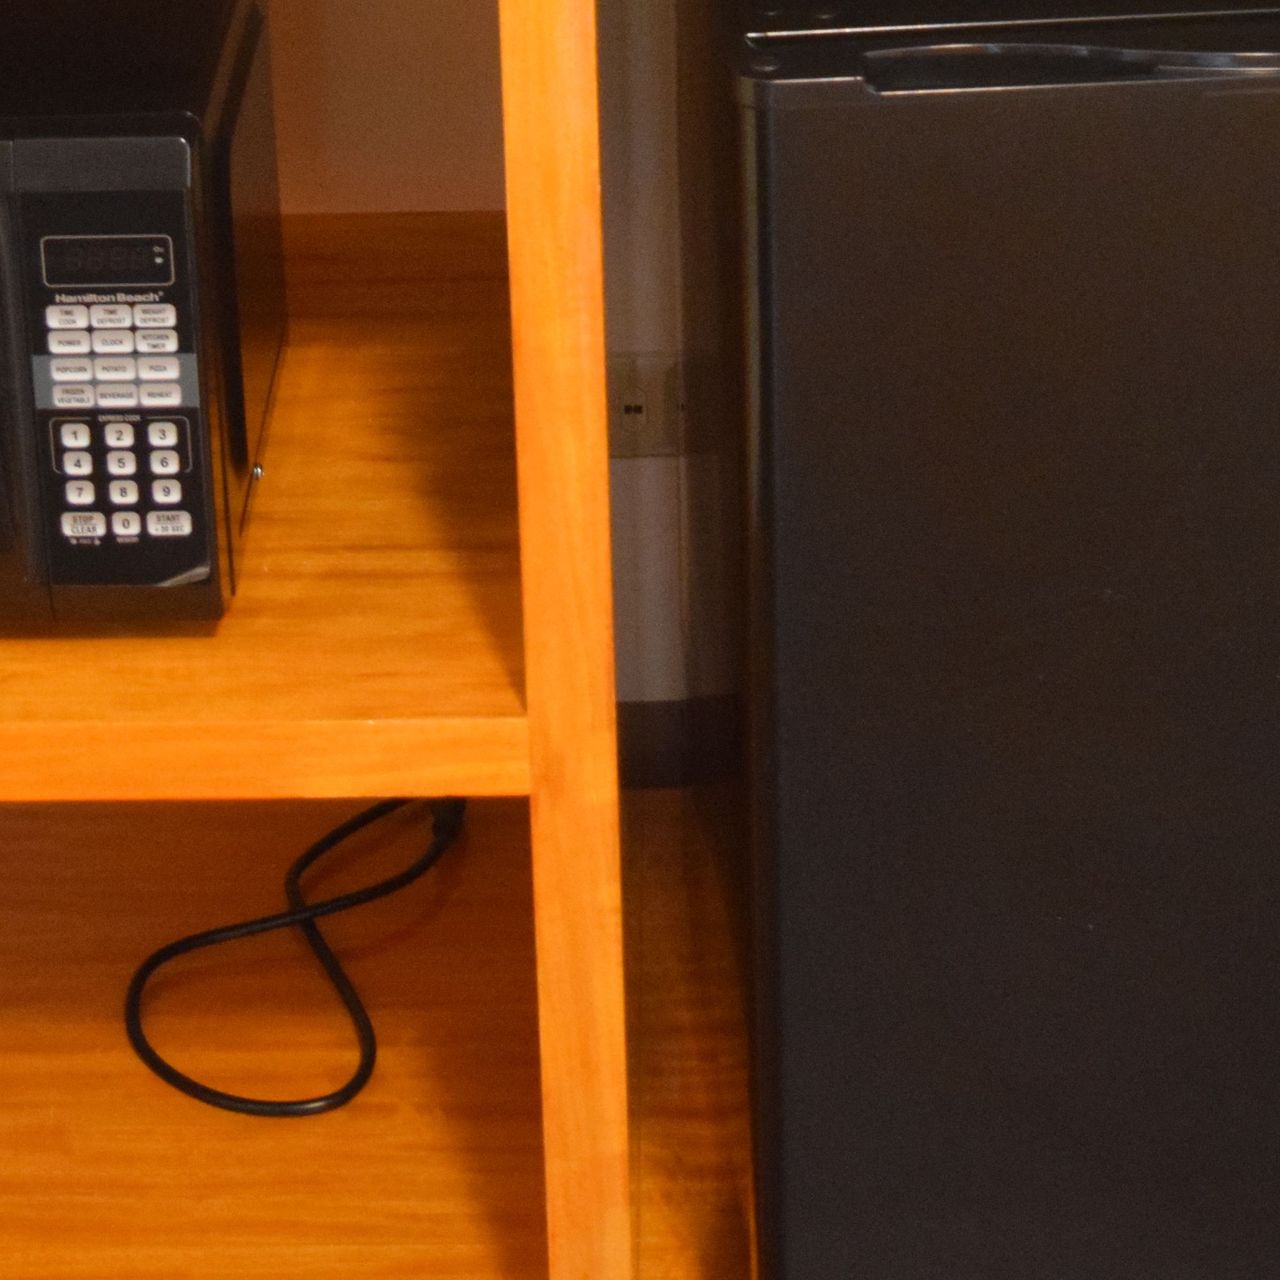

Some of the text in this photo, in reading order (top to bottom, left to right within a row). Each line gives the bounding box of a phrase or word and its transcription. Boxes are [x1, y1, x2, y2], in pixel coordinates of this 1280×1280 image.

[55, 292, 160, 303] Hamilton Beach
[55, 365, 87, 373] POPCORN
[102, 365, 127, 373] POTATO
[115, 429, 124, 441] 2
[159, 428, 168, 440] 3
[74, 458, 82, 469] 4
[117, 457, 126, 469] 5
[160, 457, 169, 468] 6
[76, 487, 85, 498] 7
[120, 486, 128, 498] 8
[163, 485, 171, 497] 9
[72, 516, 94, 524] STOP
[156, 514, 180, 522] START
[122, 518, 130, 530] 0
[71, 526, 97, 534] CLEAR
